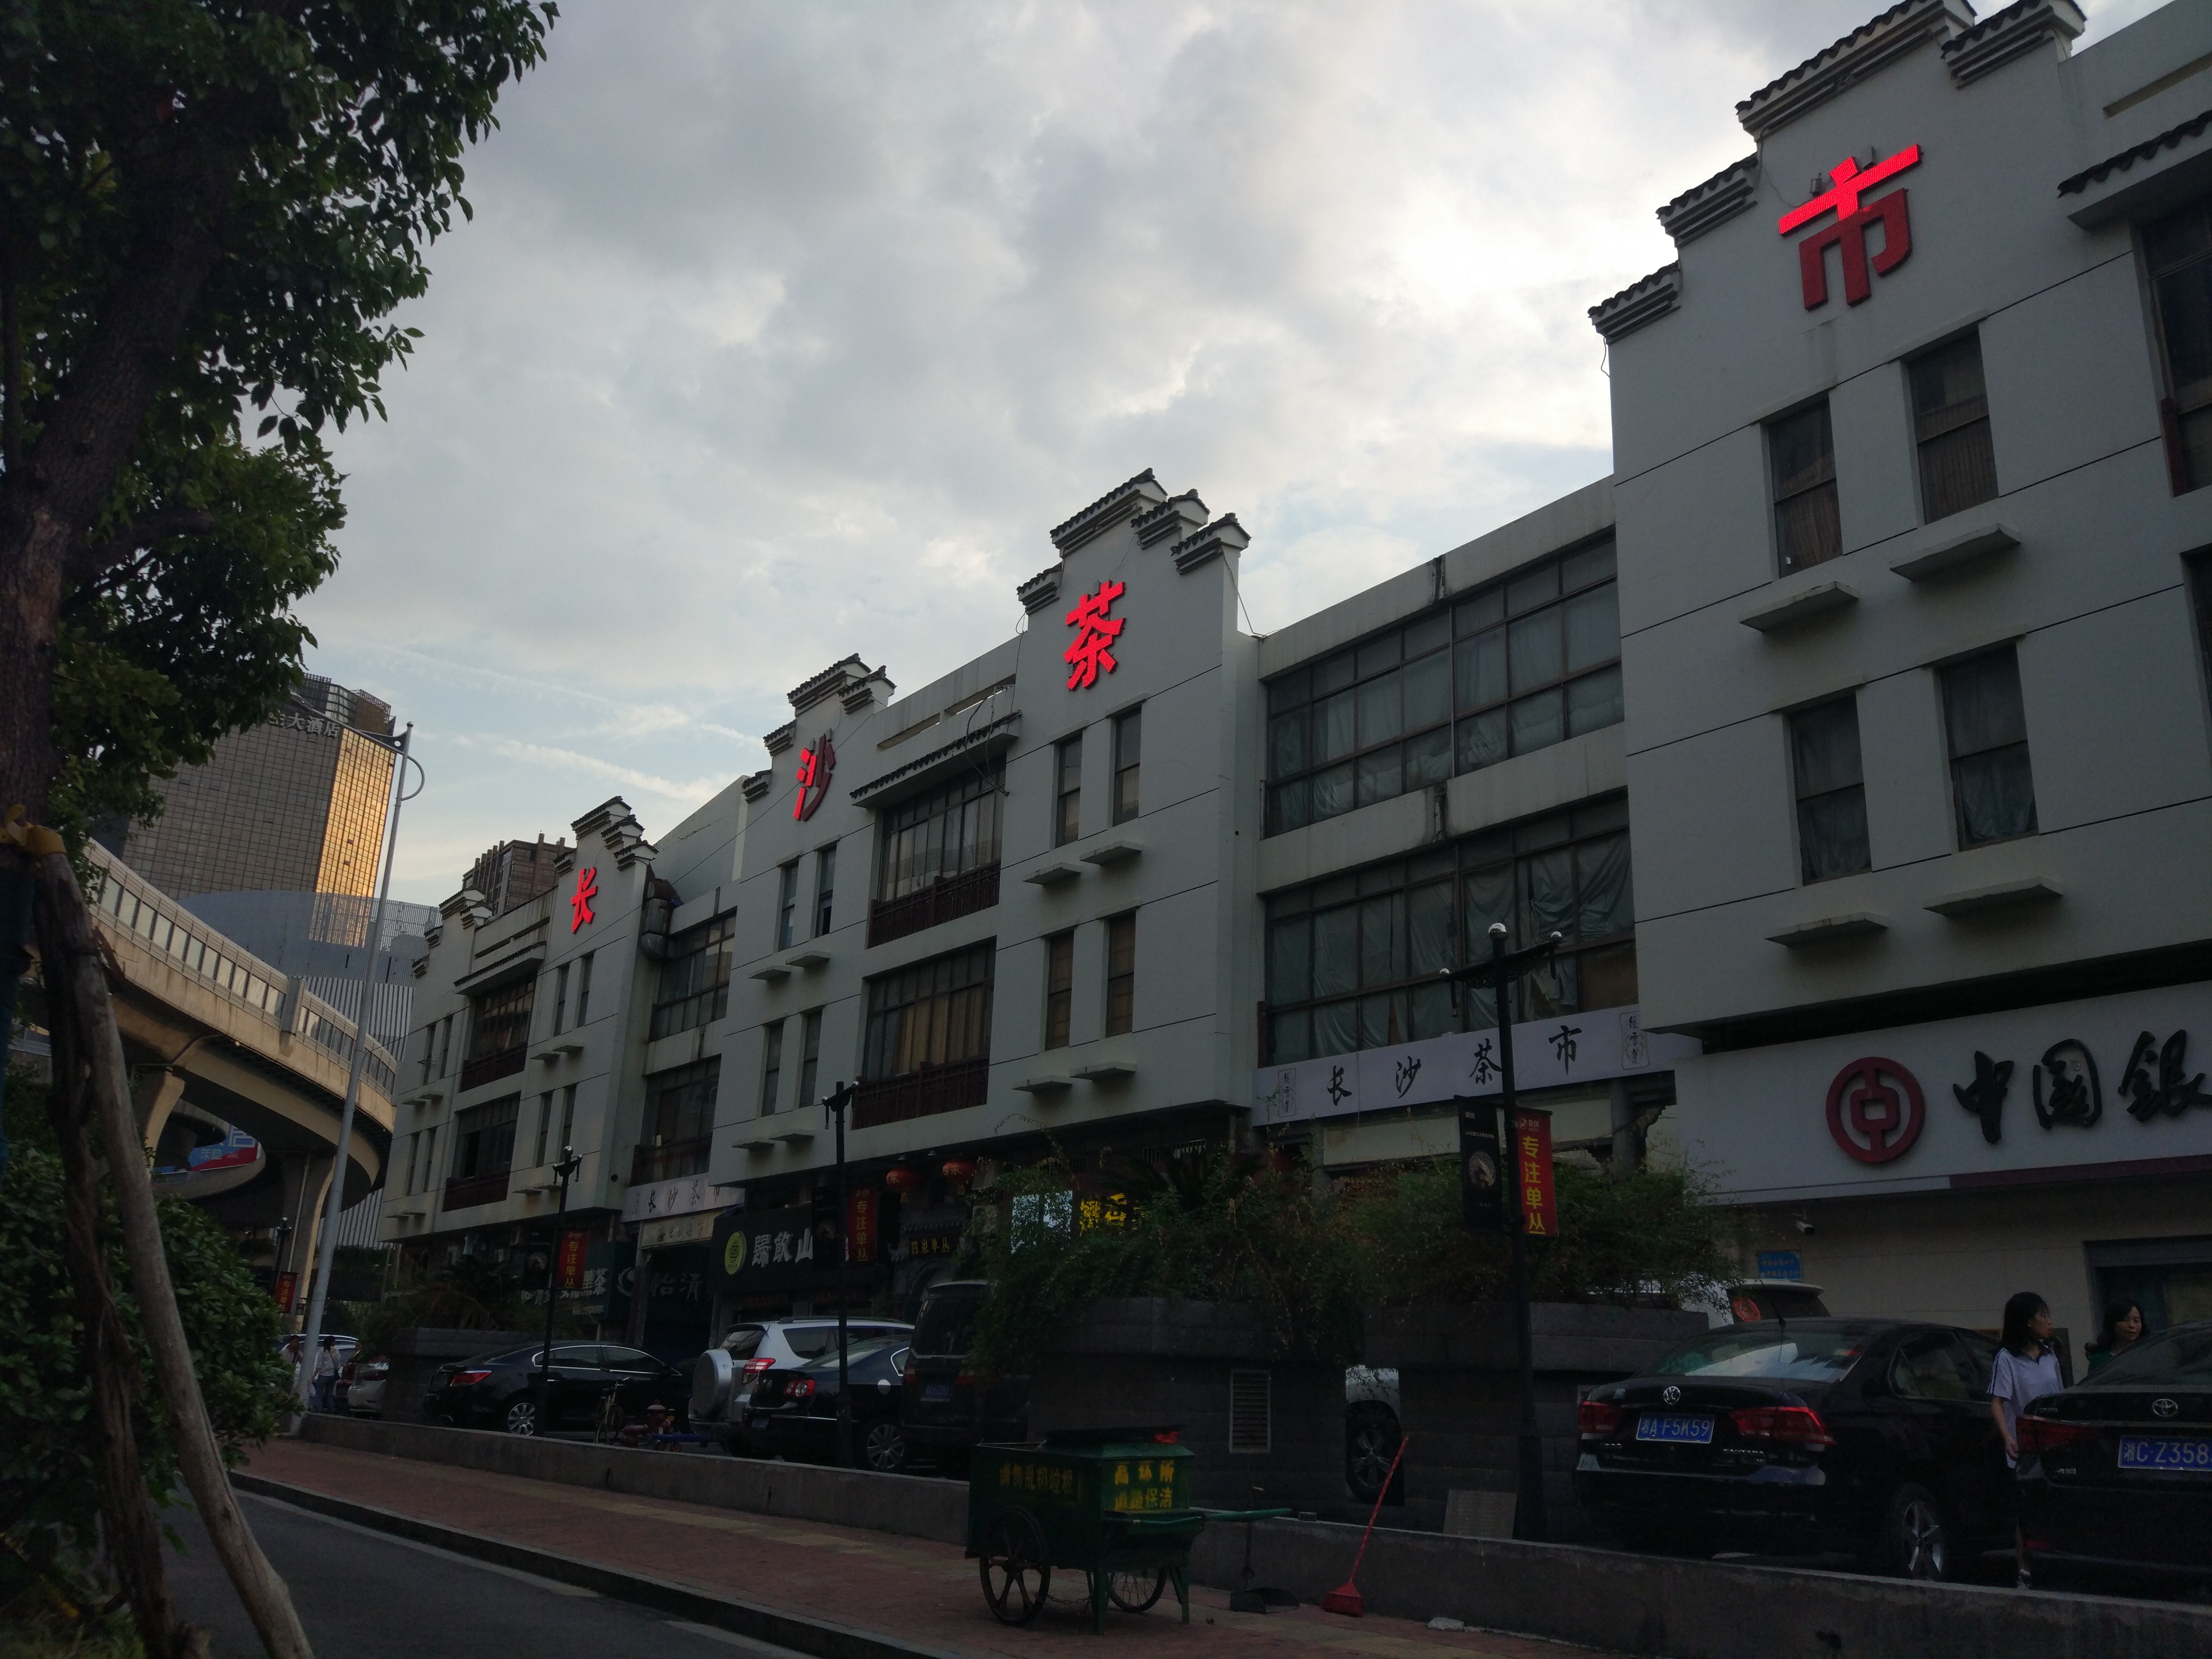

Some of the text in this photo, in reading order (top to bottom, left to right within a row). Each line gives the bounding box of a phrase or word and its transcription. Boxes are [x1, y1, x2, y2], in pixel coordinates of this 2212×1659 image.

[571, 144, 1922, 934] 长 沙 茶 市
[1327, 1025, 1582, 1106] 长沙茶市
[1522, 1136, 1546, 1235] 专注单丛
[563, 1240, 579, 1288] 专注单丛
[856, 1200, 868, 1262] 专注单丛
[2123, 1441, 2212, 1465] 湘C·Z358
